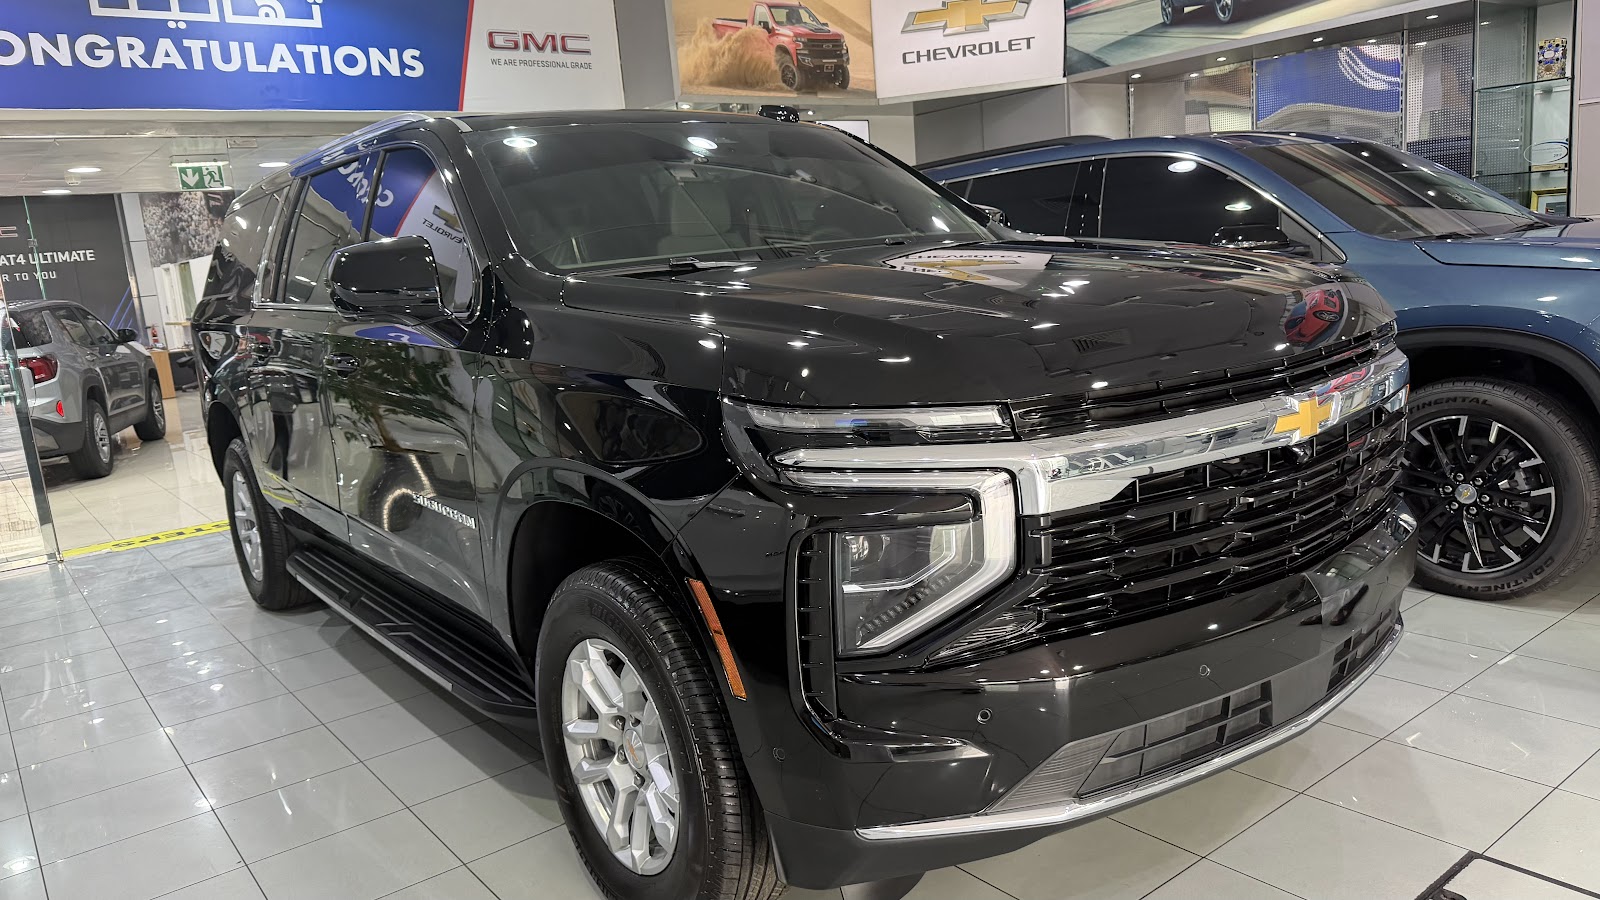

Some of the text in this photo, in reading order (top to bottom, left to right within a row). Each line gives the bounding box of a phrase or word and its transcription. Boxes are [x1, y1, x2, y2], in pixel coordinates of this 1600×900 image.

[486, 28, 592, 56] GMC
[902, 36, 1036, 65] CHEVROLET
[490, 58, 593, 70] WE ARE PROFESSIONAL GRADE
[0, 249, 96, 267] AT4 ULTIMATE
[13, 272, 29, 281] TO
[33, 270, 57, 280] YOU
